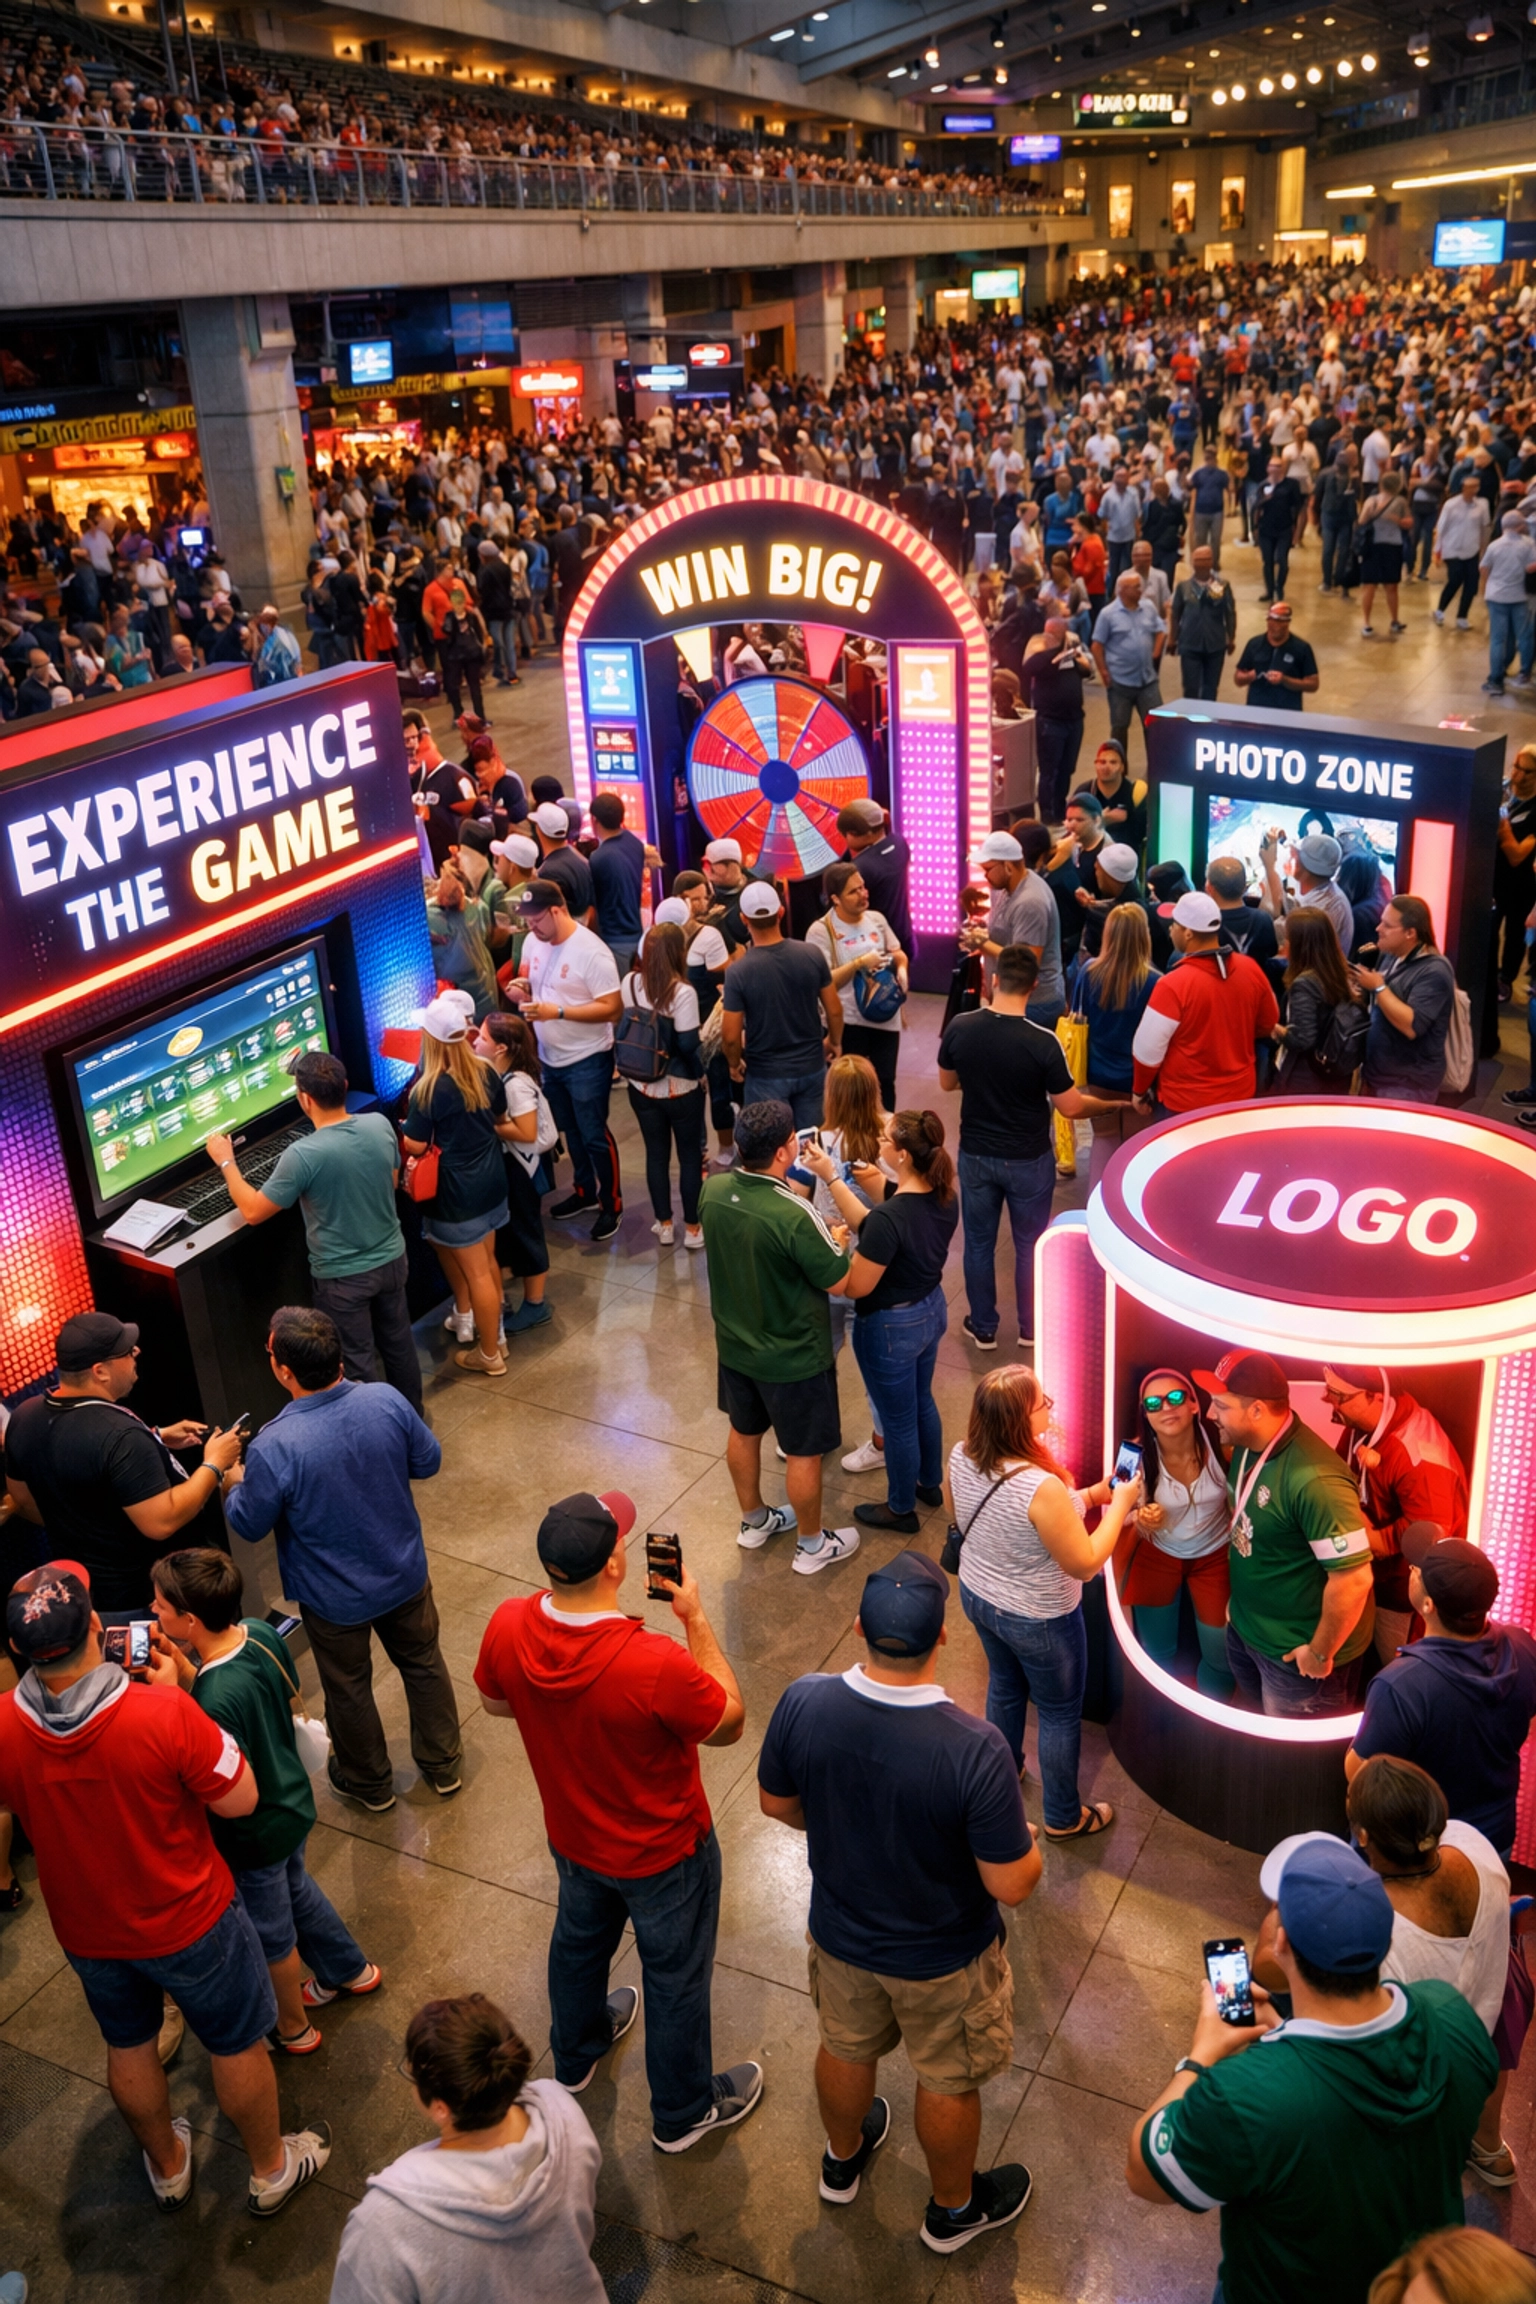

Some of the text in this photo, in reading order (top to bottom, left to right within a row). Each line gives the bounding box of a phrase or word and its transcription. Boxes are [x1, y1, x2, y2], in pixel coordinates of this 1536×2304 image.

[640, 543, 882, 615] WIN BIG!
[8, 701, 377, 896] EXPERIENCE
[1195, 738, 1413, 799] PHOTO ZONE
[65, 786, 359, 951] THE GAME
[1216, 1171, 1478, 1257] LOGO
